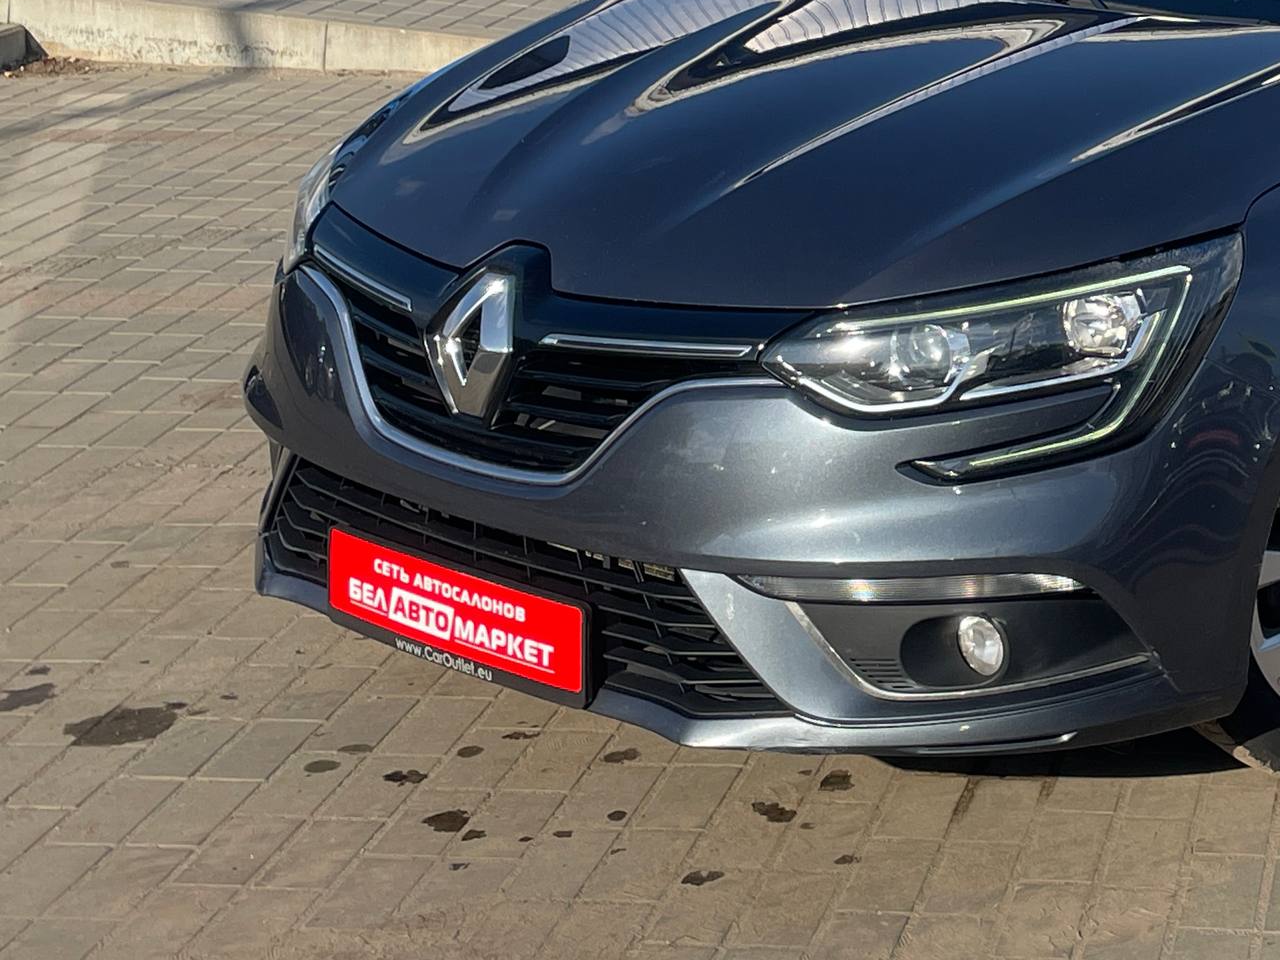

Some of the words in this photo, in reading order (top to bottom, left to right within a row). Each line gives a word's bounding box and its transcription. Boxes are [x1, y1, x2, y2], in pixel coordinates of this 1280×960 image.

[348, 577, 387, 612] БЕЛ
[393, 595, 449, 631] АВТО
[453, 616, 555, 667] МАРКЕТ
[374, 558, 410, 584] СЕТЬ
[413, 573, 526, 622] АВТОСАЛОНОВ
[395, 637, 493, 681] www.CarOutlet.eu
